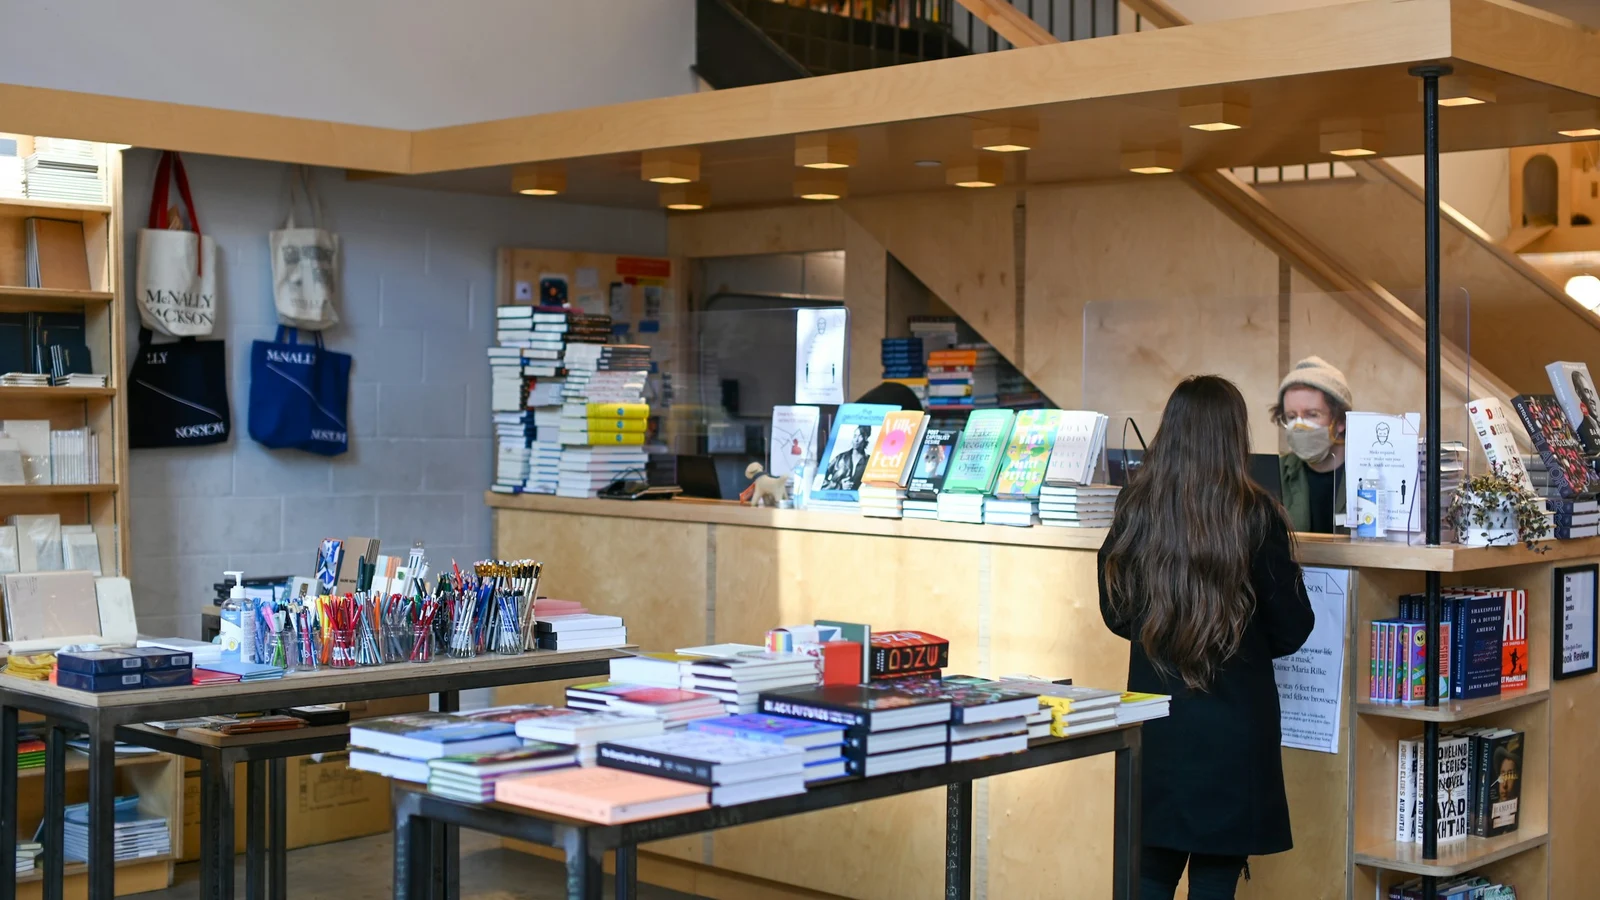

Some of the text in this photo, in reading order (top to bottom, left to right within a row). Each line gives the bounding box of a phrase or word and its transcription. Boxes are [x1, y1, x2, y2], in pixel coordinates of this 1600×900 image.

[146, 288, 213, 308] McNALLY
[150, 307, 213, 326] ACKSON
[1517, 403, 1535, 433] OTTOLENGHI
[1307, 585, 1323, 593] SON
[1471, 606, 1501, 614] SHAKESPEARE
[1563, 650, 1589, 663] ook Review
[1292, 665, 1310, 674] Maria
[1311, 667, 1327, 676] Rilke
[1311, 684, 1324, 693] from
[1468, 682, 1481, 690] JAMES
[1294, 693, 1310, 701] fellow
[1311, 695, 1337, 704] browsers
[764, 699, 791, 714] BLACK
[1438, 774, 1464, 791] NOVEL
[1438, 798, 1466, 820] YAD
